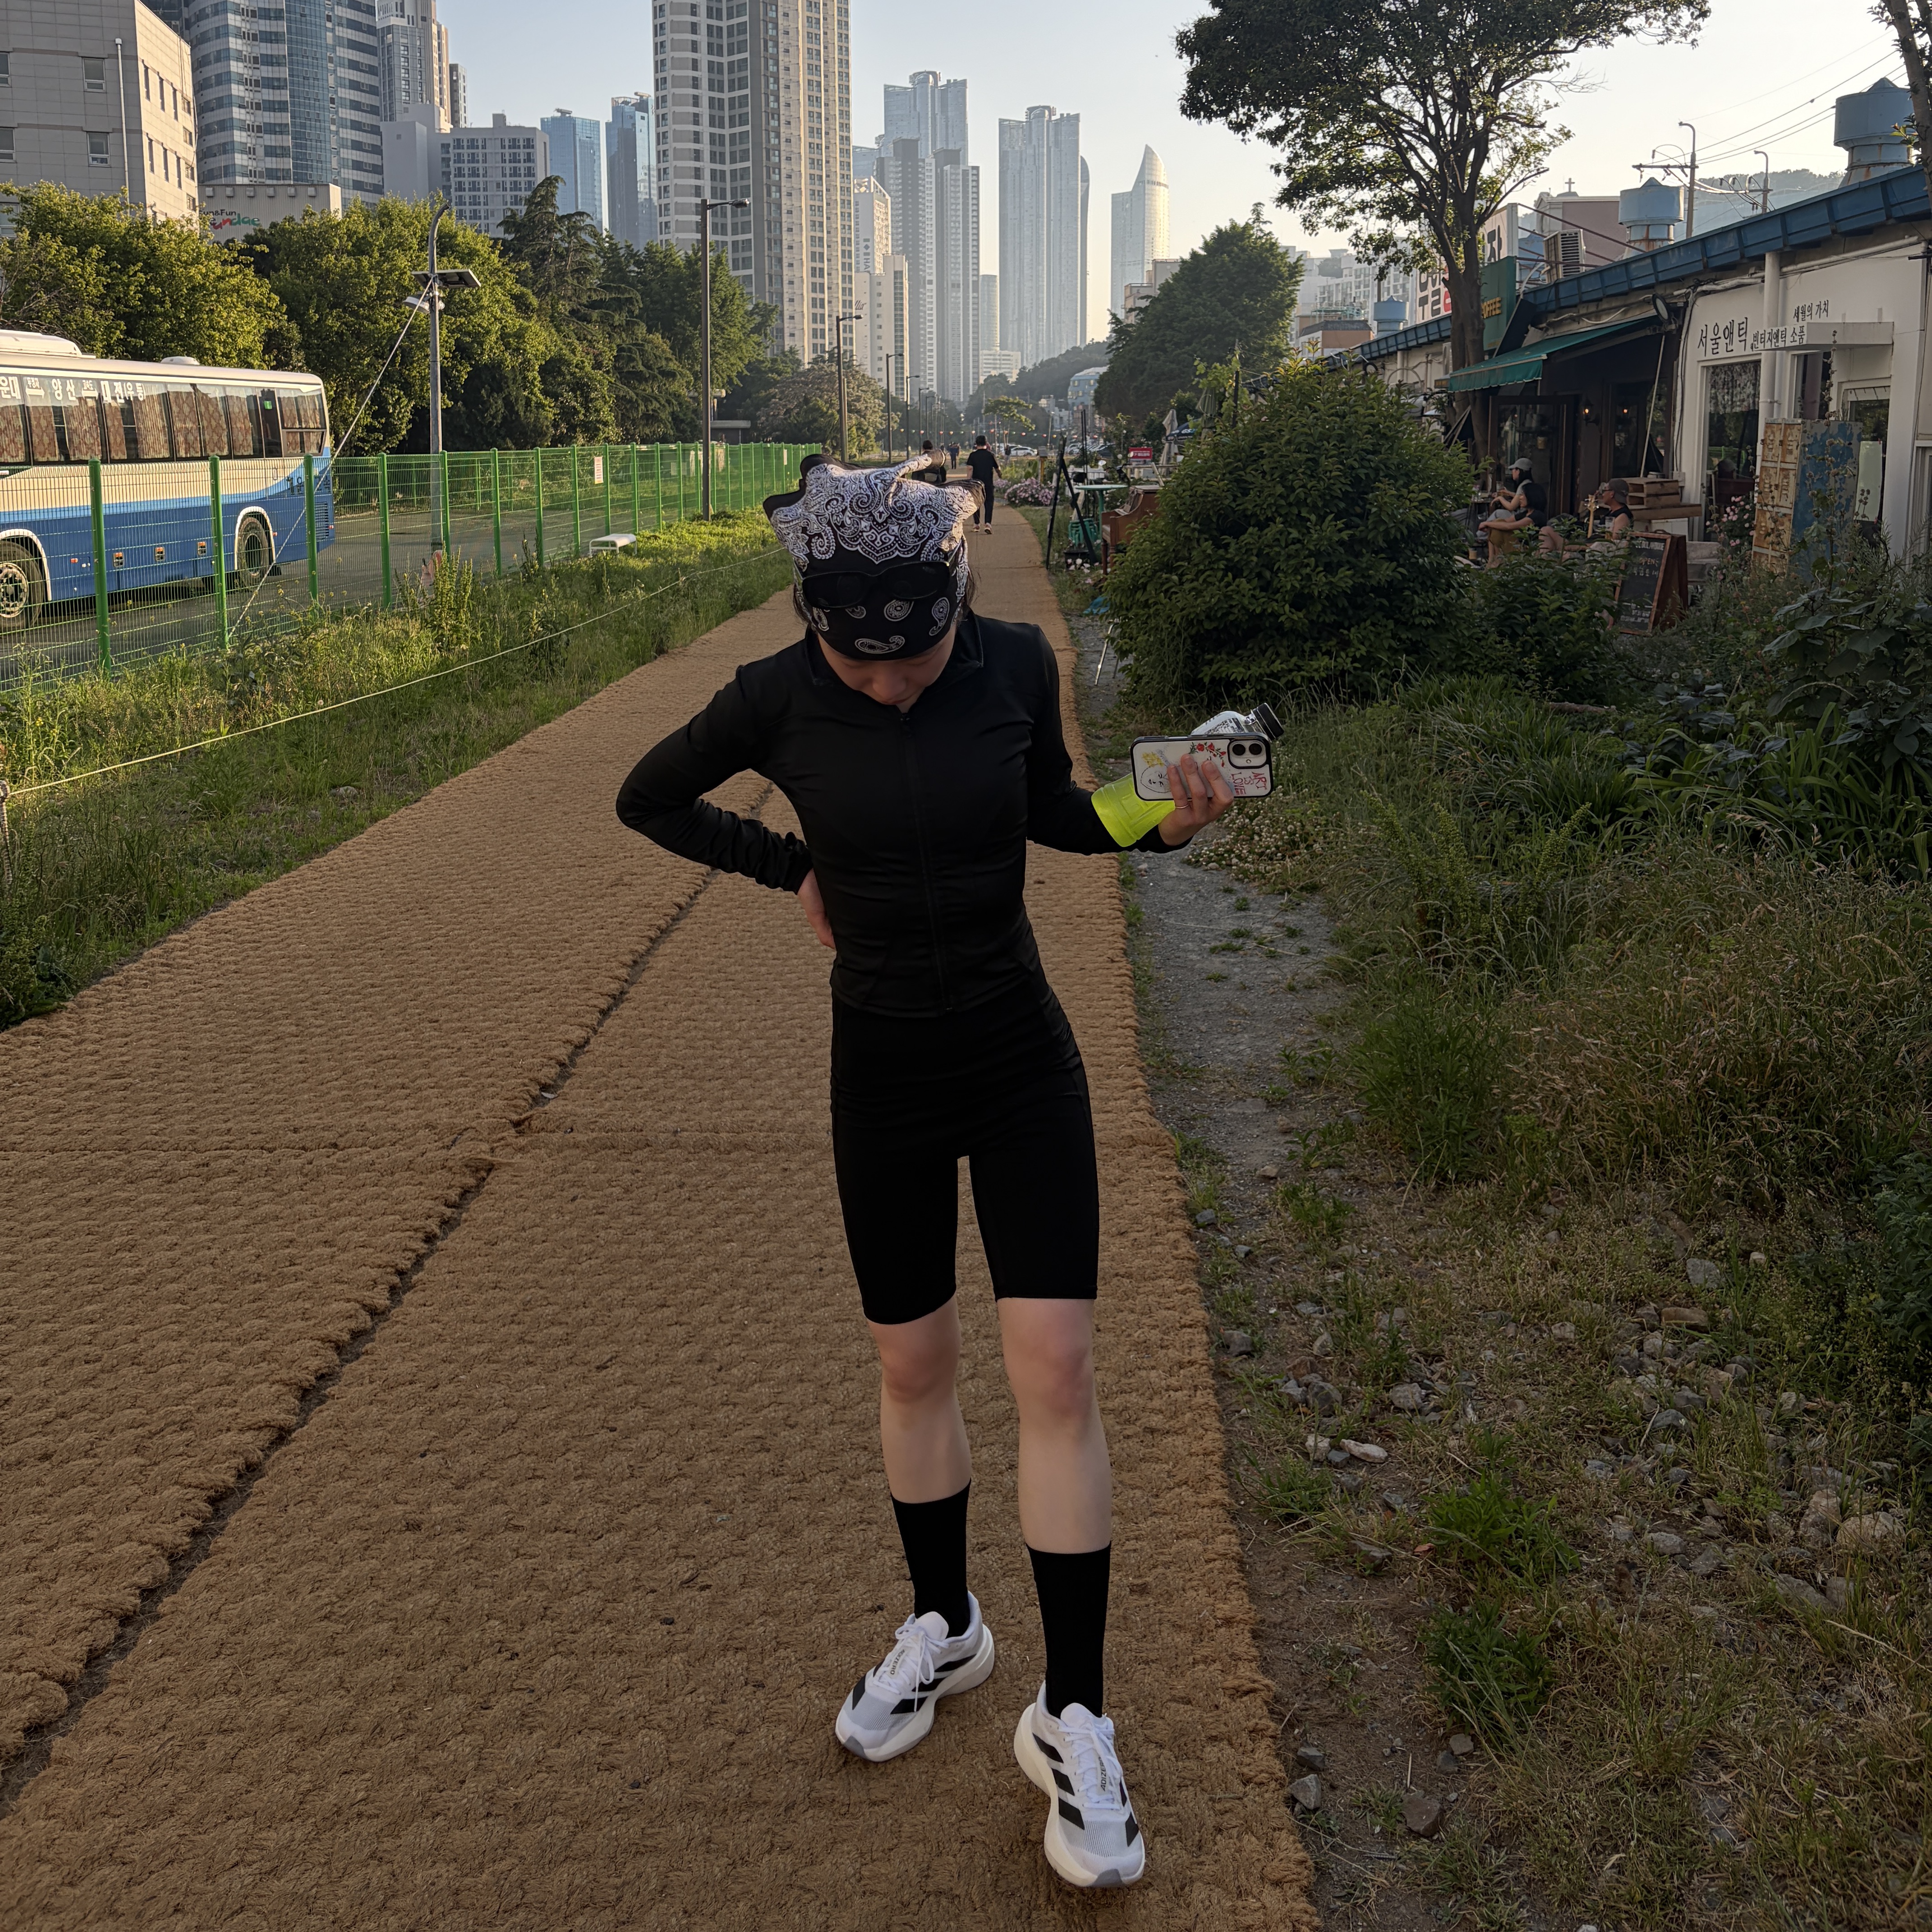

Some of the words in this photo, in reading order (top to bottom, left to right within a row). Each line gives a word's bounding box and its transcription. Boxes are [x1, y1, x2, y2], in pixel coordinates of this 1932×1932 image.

[1793, 303, 1813, 323] 세월의
[1815, 299, 1829, 319] 가치
[1697, 317, 1748, 357] 서울앤틱
[1789, 325, 1806, 345] 소품
[1231, 772, 1246, 796] LOVE
[1251, 771, 1268, 790] ART
